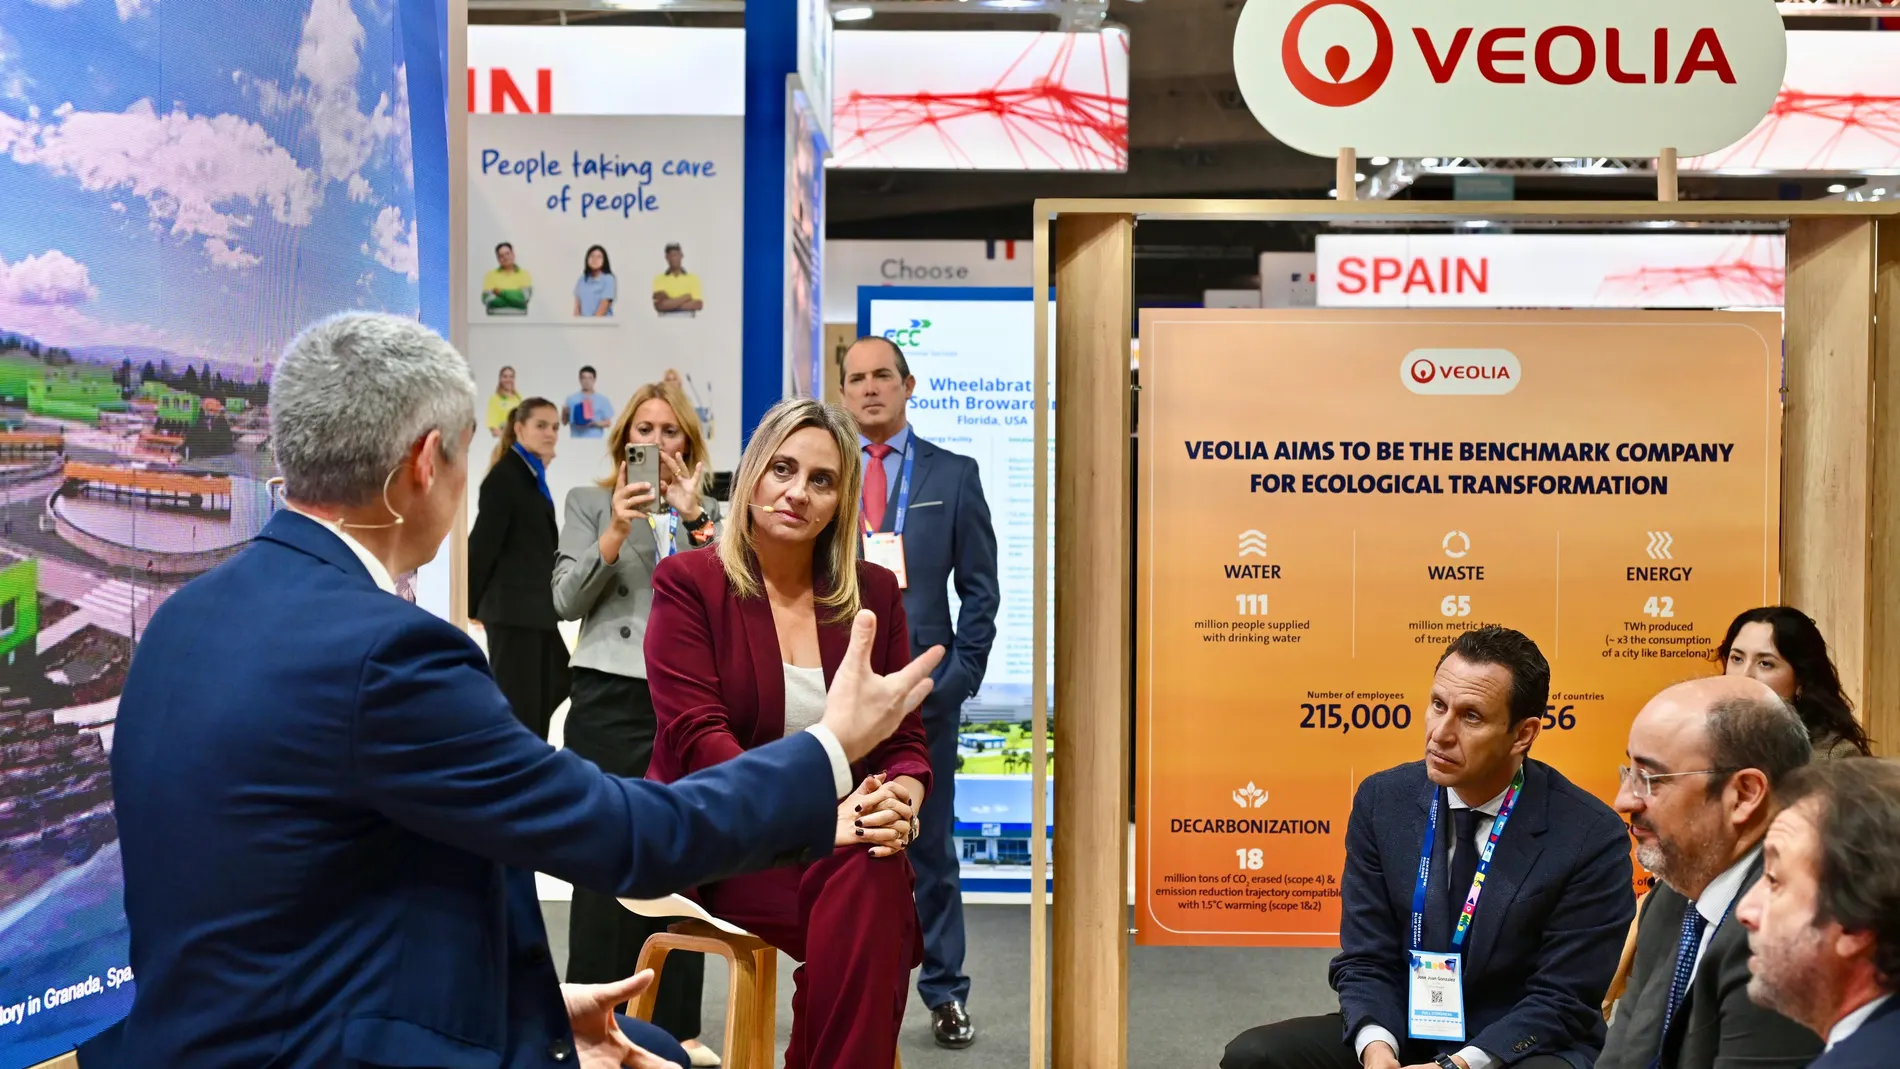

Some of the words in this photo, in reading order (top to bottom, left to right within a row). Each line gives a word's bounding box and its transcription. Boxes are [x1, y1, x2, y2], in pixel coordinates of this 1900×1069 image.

[1411, 25, 1737, 85] VEOLIA
[481, 149, 562, 183] People
[572, 150, 653, 185] taking
[661, 158, 717, 177] care
[546, 185, 572, 212] of
[581, 186, 659, 218] people
[880, 258, 969, 280] Choose
[1336, 256, 1488, 294] SPAIN
[1439, 365, 1510, 379] VEOLIA
[930, 377, 1051, 392] Wheelabrat
[909, 395, 959, 410] South
[1005, 415, 1028, 425] USA
[1184, 440, 1269, 460] VEOLIA
[1274, 441, 1335, 461] AIMS
[1340, 441, 1371, 461] TO
[1377, 441, 1404, 461] BE
[1409, 442, 1453, 461] THE
[1459, 442, 1610, 462] BENCHMARK
[1616, 443, 1735, 463] COMPANY
[1250, 473, 1296, 493] FOR
[1302, 474, 1444, 494] ECOLOGICAL
[1448, 475, 1668, 495] TRANSFORMATION
[1223, 564, 1282, 579] WATER
[1427, 565, 1484, 580] WASTE
[1626, 566, 1693, 581] ENERGY
[1235, 593, 1268, 615] 111
[1440, 595, 1471, 617] 65
[1643, 595, 1675, 618] 42
[1194, 619, 1229, 629] million
[1231, 619, 1265, 632] people
[1267, 619, 1310, 632] supplied
[1408, 620, 1443, 630] million
[1446, 621, 1478, 630] metric
[1623, 621, 1647, 631] TWh
[1648, 621, 1694, 633] produced
[1203, 633, 1226, 642] with
[1228, 633, 1270, 645] drinking
[1272, 635, 1301, 643] water
[1414, 633, 1425, 643] of
[1427, 634, 1458, 644] treate
[1617, 635, 1628, 645] x3
[1630, 635, 1646, 645] the
[1648, 635, 1711, 647] consumption
[1601, 648, 1613, 658] of
[1614, 650, 1620, 658] a
[1621, 648, 1640, 660] city
[1641, 648, 1658, 658] like
[1307, 690, 1343, 699] Number
[1345, 690, 1355, 699] of
[1356, 690, 1405, 701] employees
[1551, 691, 1562, 700] of
[1563, 691, 1605, 700] countries
[1299, 703, 1412, 734] 215,000
[1542, 704, 1577, 730] 56
[1170, 818, 1331, 834] DECARBONIZATION
[1235, 848, 1264, 870] 18
[1163, 873, 1197, 884] million
[1198, 874, 1219, 884] tons
[1220, 873, 1231, 884] of
[1251, 874, 1282, 884] erased
[1284, 874, 1314, 886] (scope
[1315, 874, 1325, 885] 4)
[1326, 874, 1336, 884] &
[1155, 887, 1197, 896] emission
[1199, 887, 1243, 896] reduction
[1245, 887, 1290, 899] trajectory
[1177, 900, 1200, 909] with
[1201, 900, 1223, 909] 1.5°C
[1224, 901, 1267, 912] warming
[1268, 900, 1299, 912] (scope
[1299, 900, 1322, 912] 1&2)
[28, 995, 41, 1016] in
[44, 974, 104, 1009] Granada,
